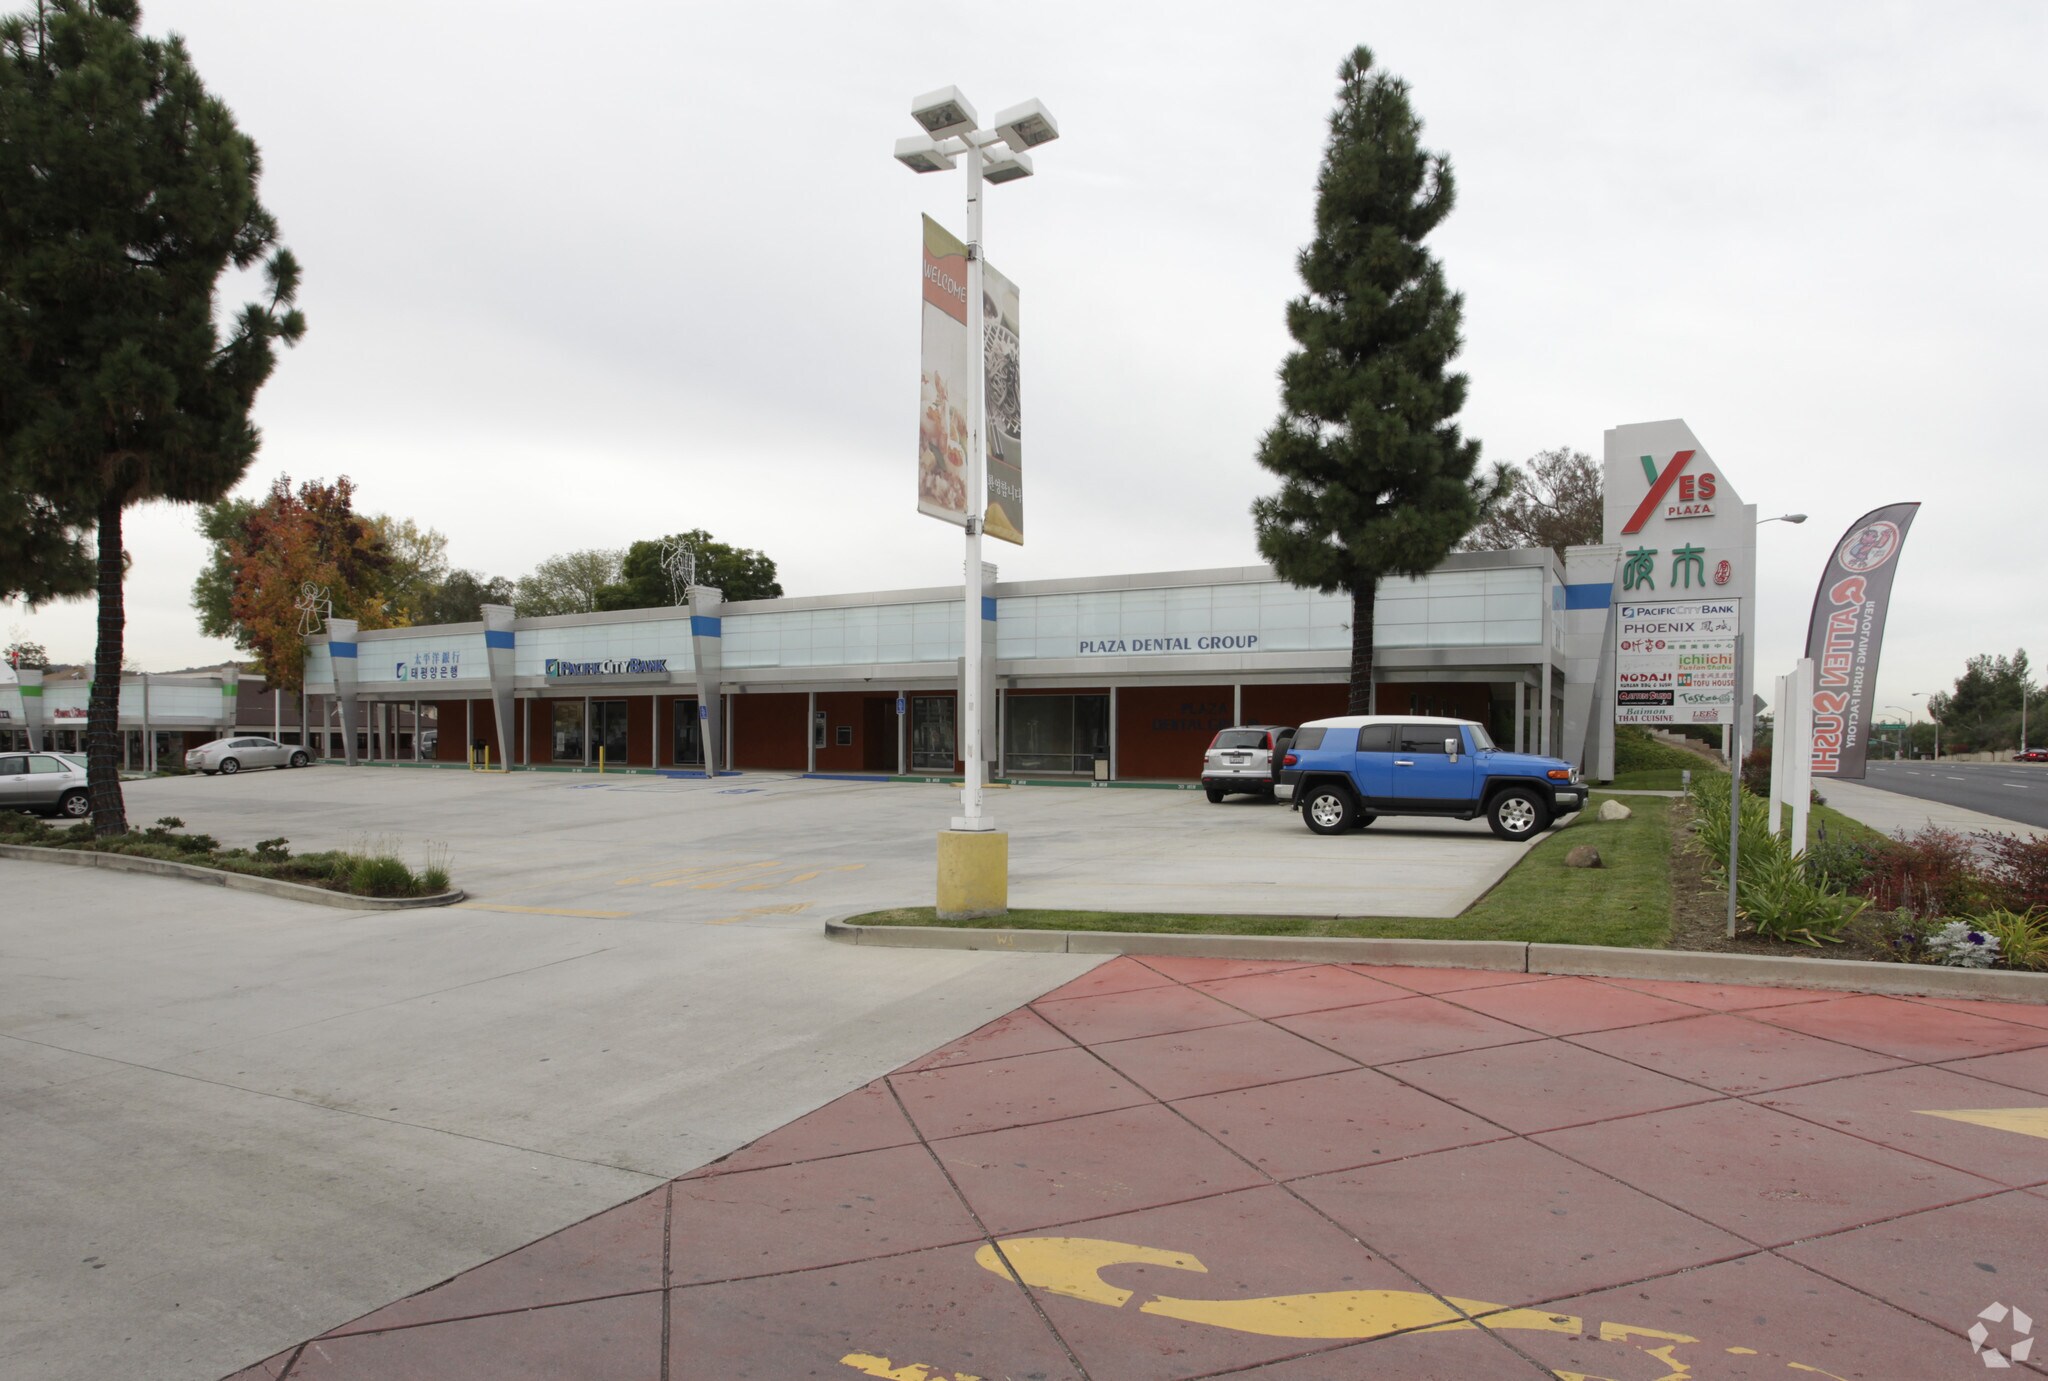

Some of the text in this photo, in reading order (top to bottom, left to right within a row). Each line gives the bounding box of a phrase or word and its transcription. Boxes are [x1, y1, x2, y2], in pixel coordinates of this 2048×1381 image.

[923, 259, 967, 303] WELCOME
[1620, 450, 1717, 535] YES
[1668, 504, 1711, 516] PLAZA
[1624, 622, 1695, 634] PHOENIX
[1080, 635, 1258, 653] PLAZA DENTAL GROUP
[411, 665, 458, 680] 태평양은행
[1620, 673, 1672, 682] NODAJI
